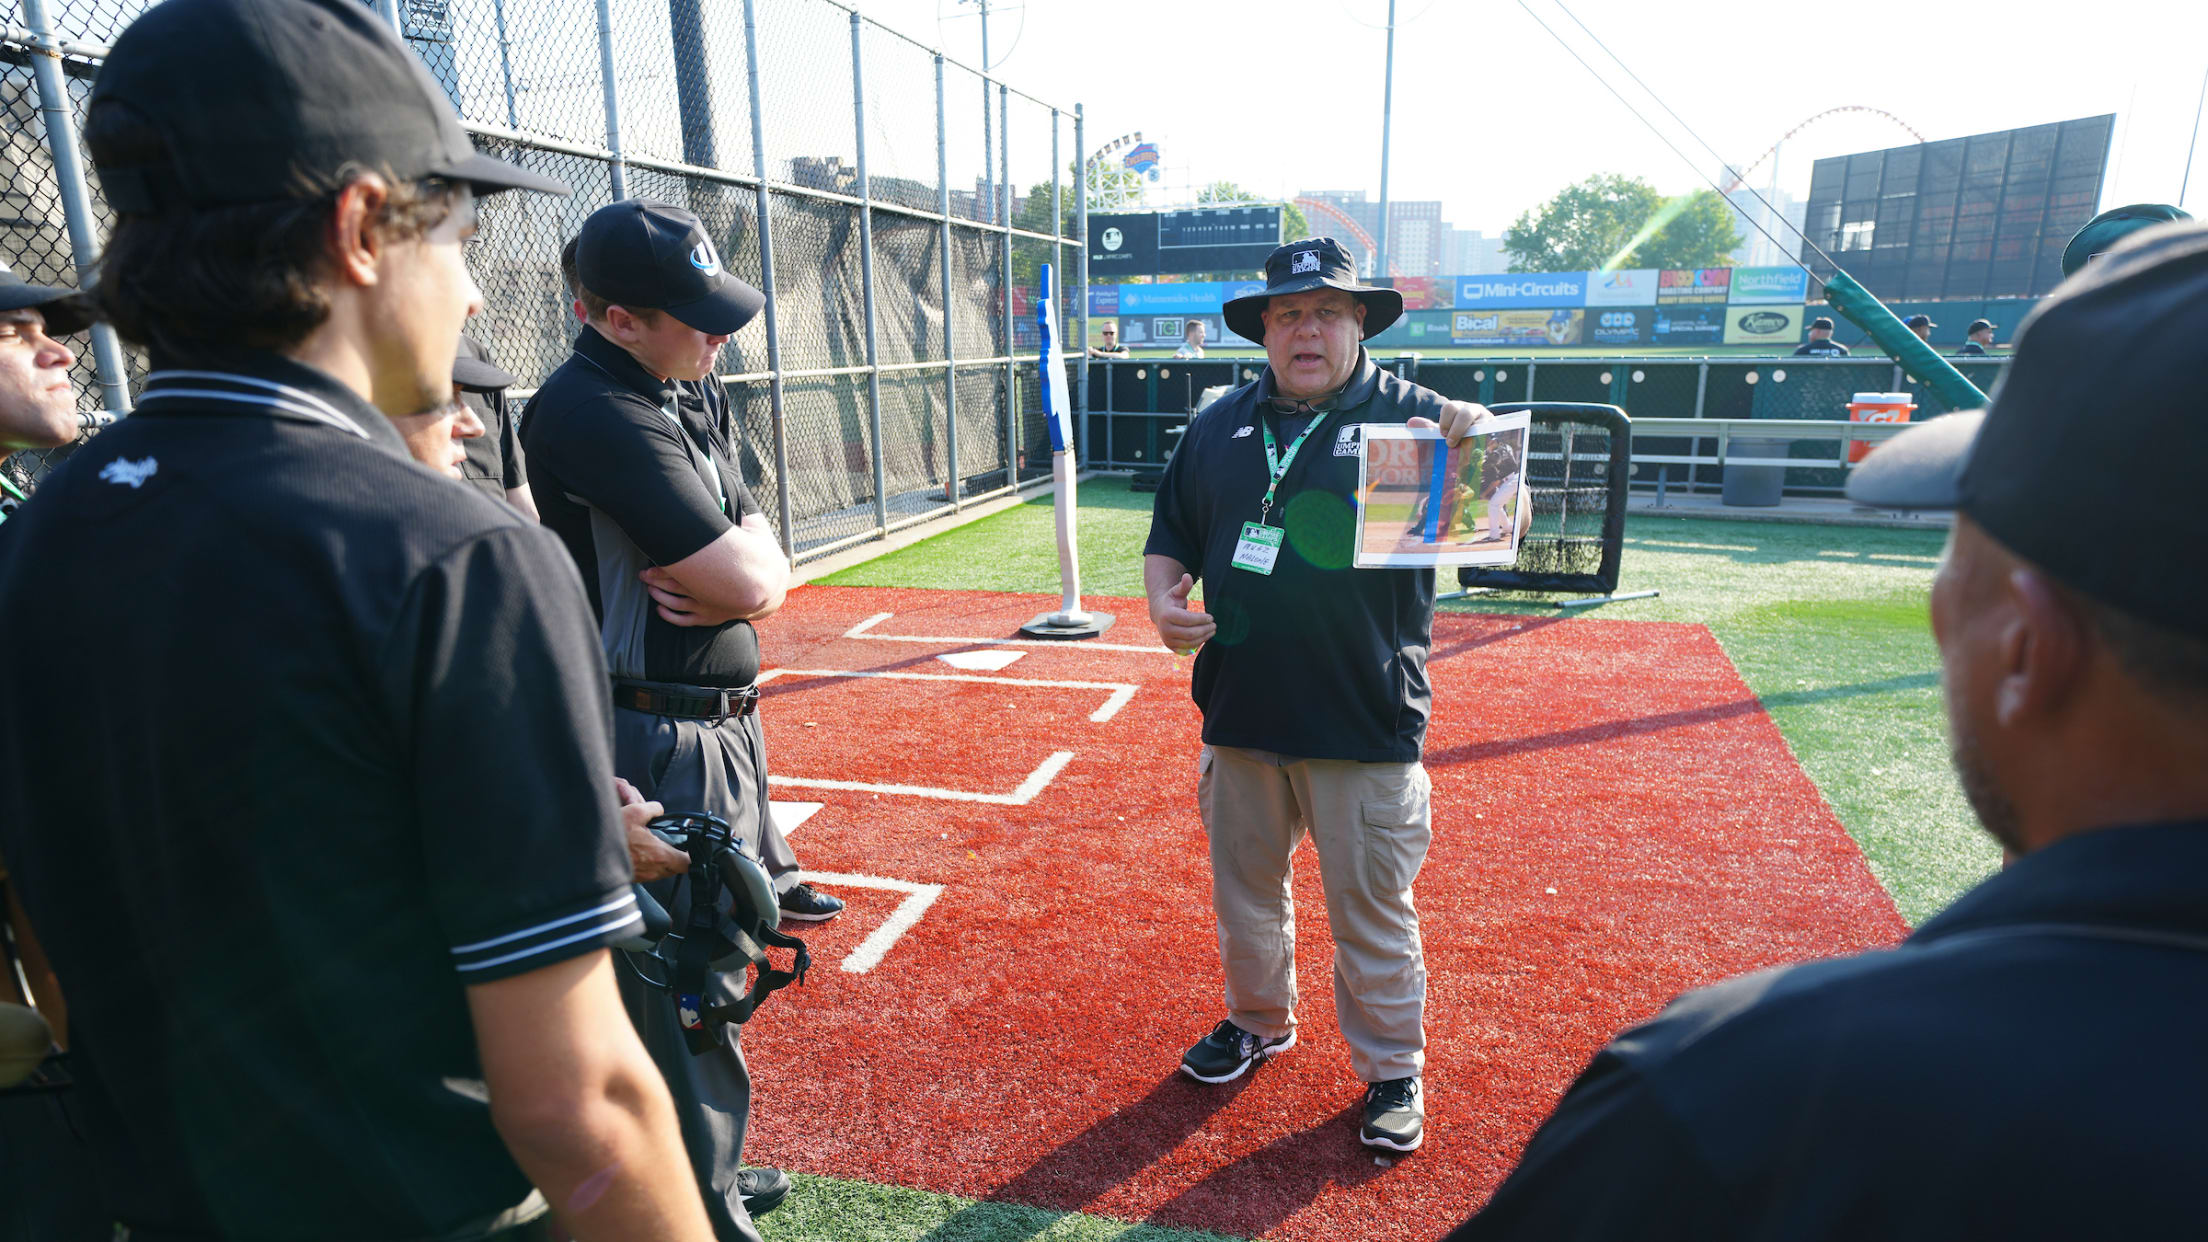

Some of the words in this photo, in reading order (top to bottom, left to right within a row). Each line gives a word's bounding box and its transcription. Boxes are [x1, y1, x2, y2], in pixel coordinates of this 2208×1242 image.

[1738, 273, 1802, 285] Northfield
[1485, 281, 1579, 297] Mini-Circuits
[1456, 314, 1497, 331] Bical
[1335, 448, 1360, 456] CAM
[1336, 442, 1360, 450] UMPI
